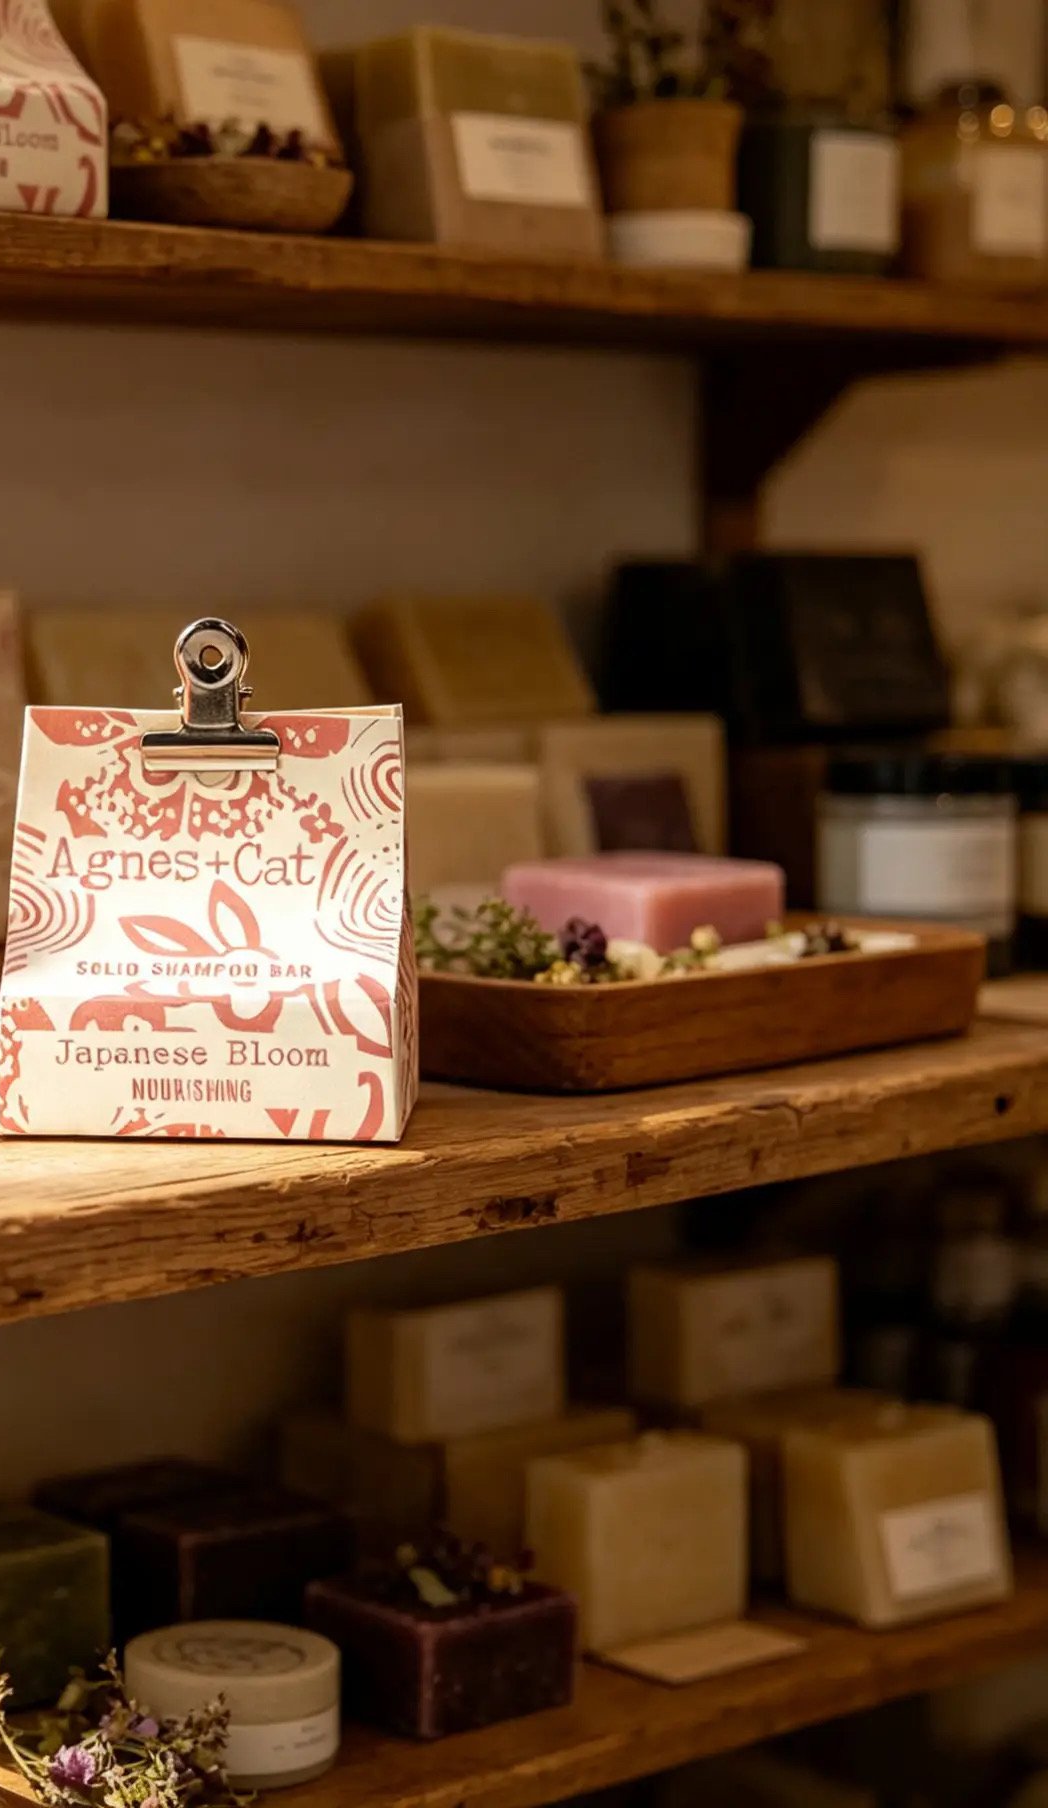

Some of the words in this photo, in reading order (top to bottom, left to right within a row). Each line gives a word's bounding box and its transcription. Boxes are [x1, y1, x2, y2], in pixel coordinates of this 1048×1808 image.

[45, 836, 316, 890] Agnes+Cat
[75, 960, 140, 977] SOLID
[151, 961, 259, 978] SHAMPOO
[269, 963, 313, 979] BAR
[55, 1039, 209, 1072] Japanese
[226, 1040, 331, 1068] Bloom
[131, 1078, 252, 1103] NOURISHING
